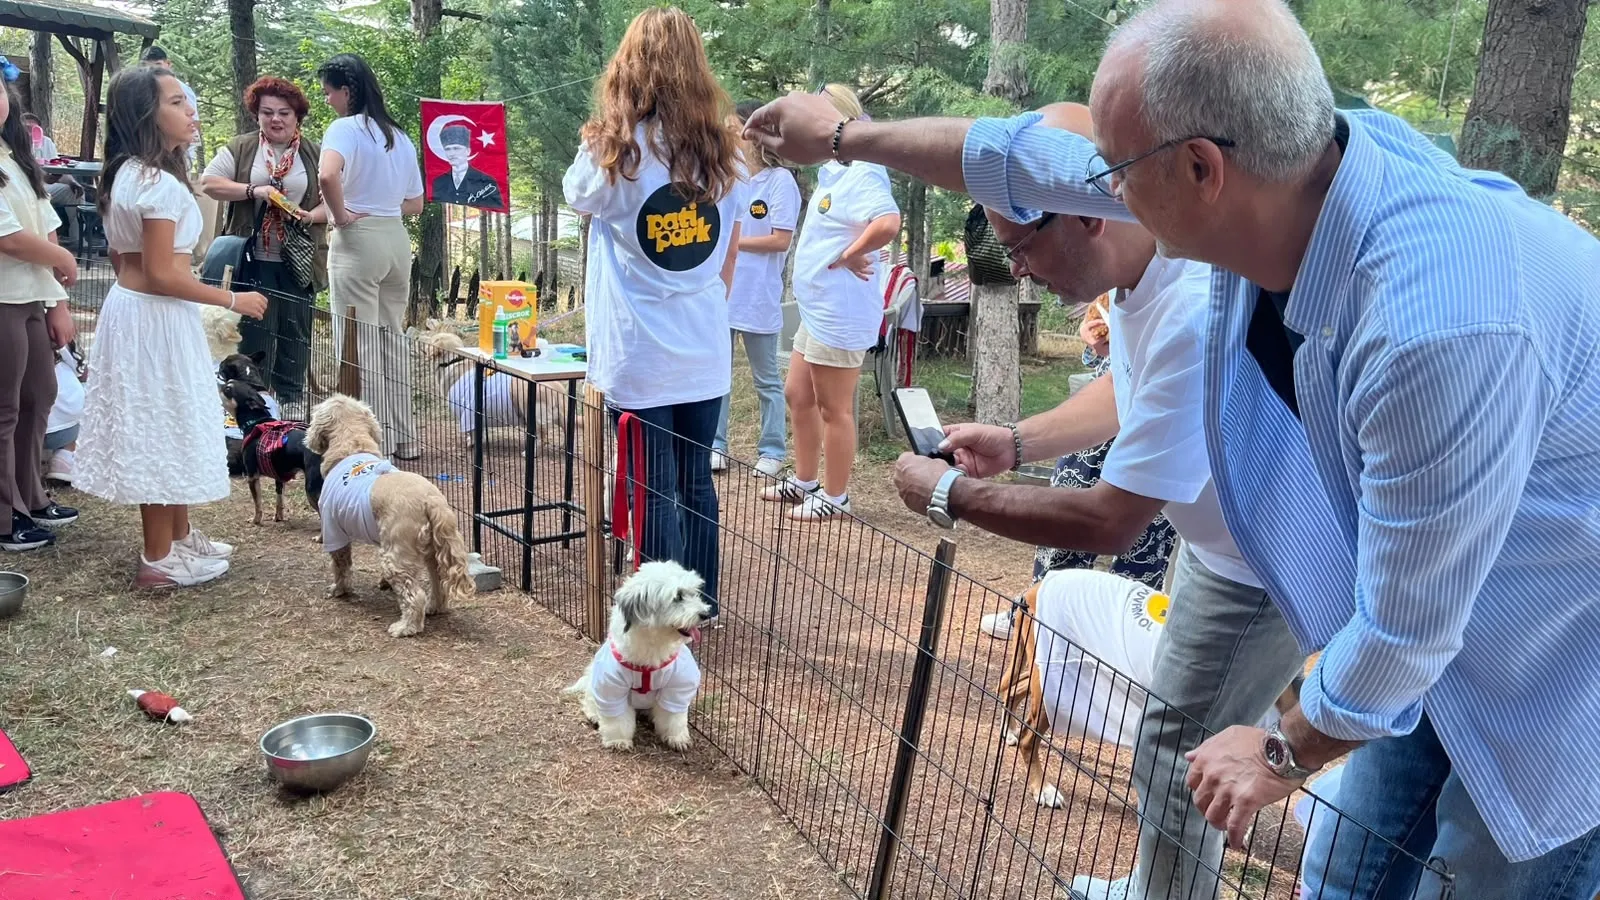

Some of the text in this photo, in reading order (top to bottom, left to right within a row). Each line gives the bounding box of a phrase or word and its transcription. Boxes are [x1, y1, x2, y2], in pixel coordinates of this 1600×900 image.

[646, 202, 697, 239] pati
[656, 216, 712, 252] park
[1138, 617, 1154, 632] OL
